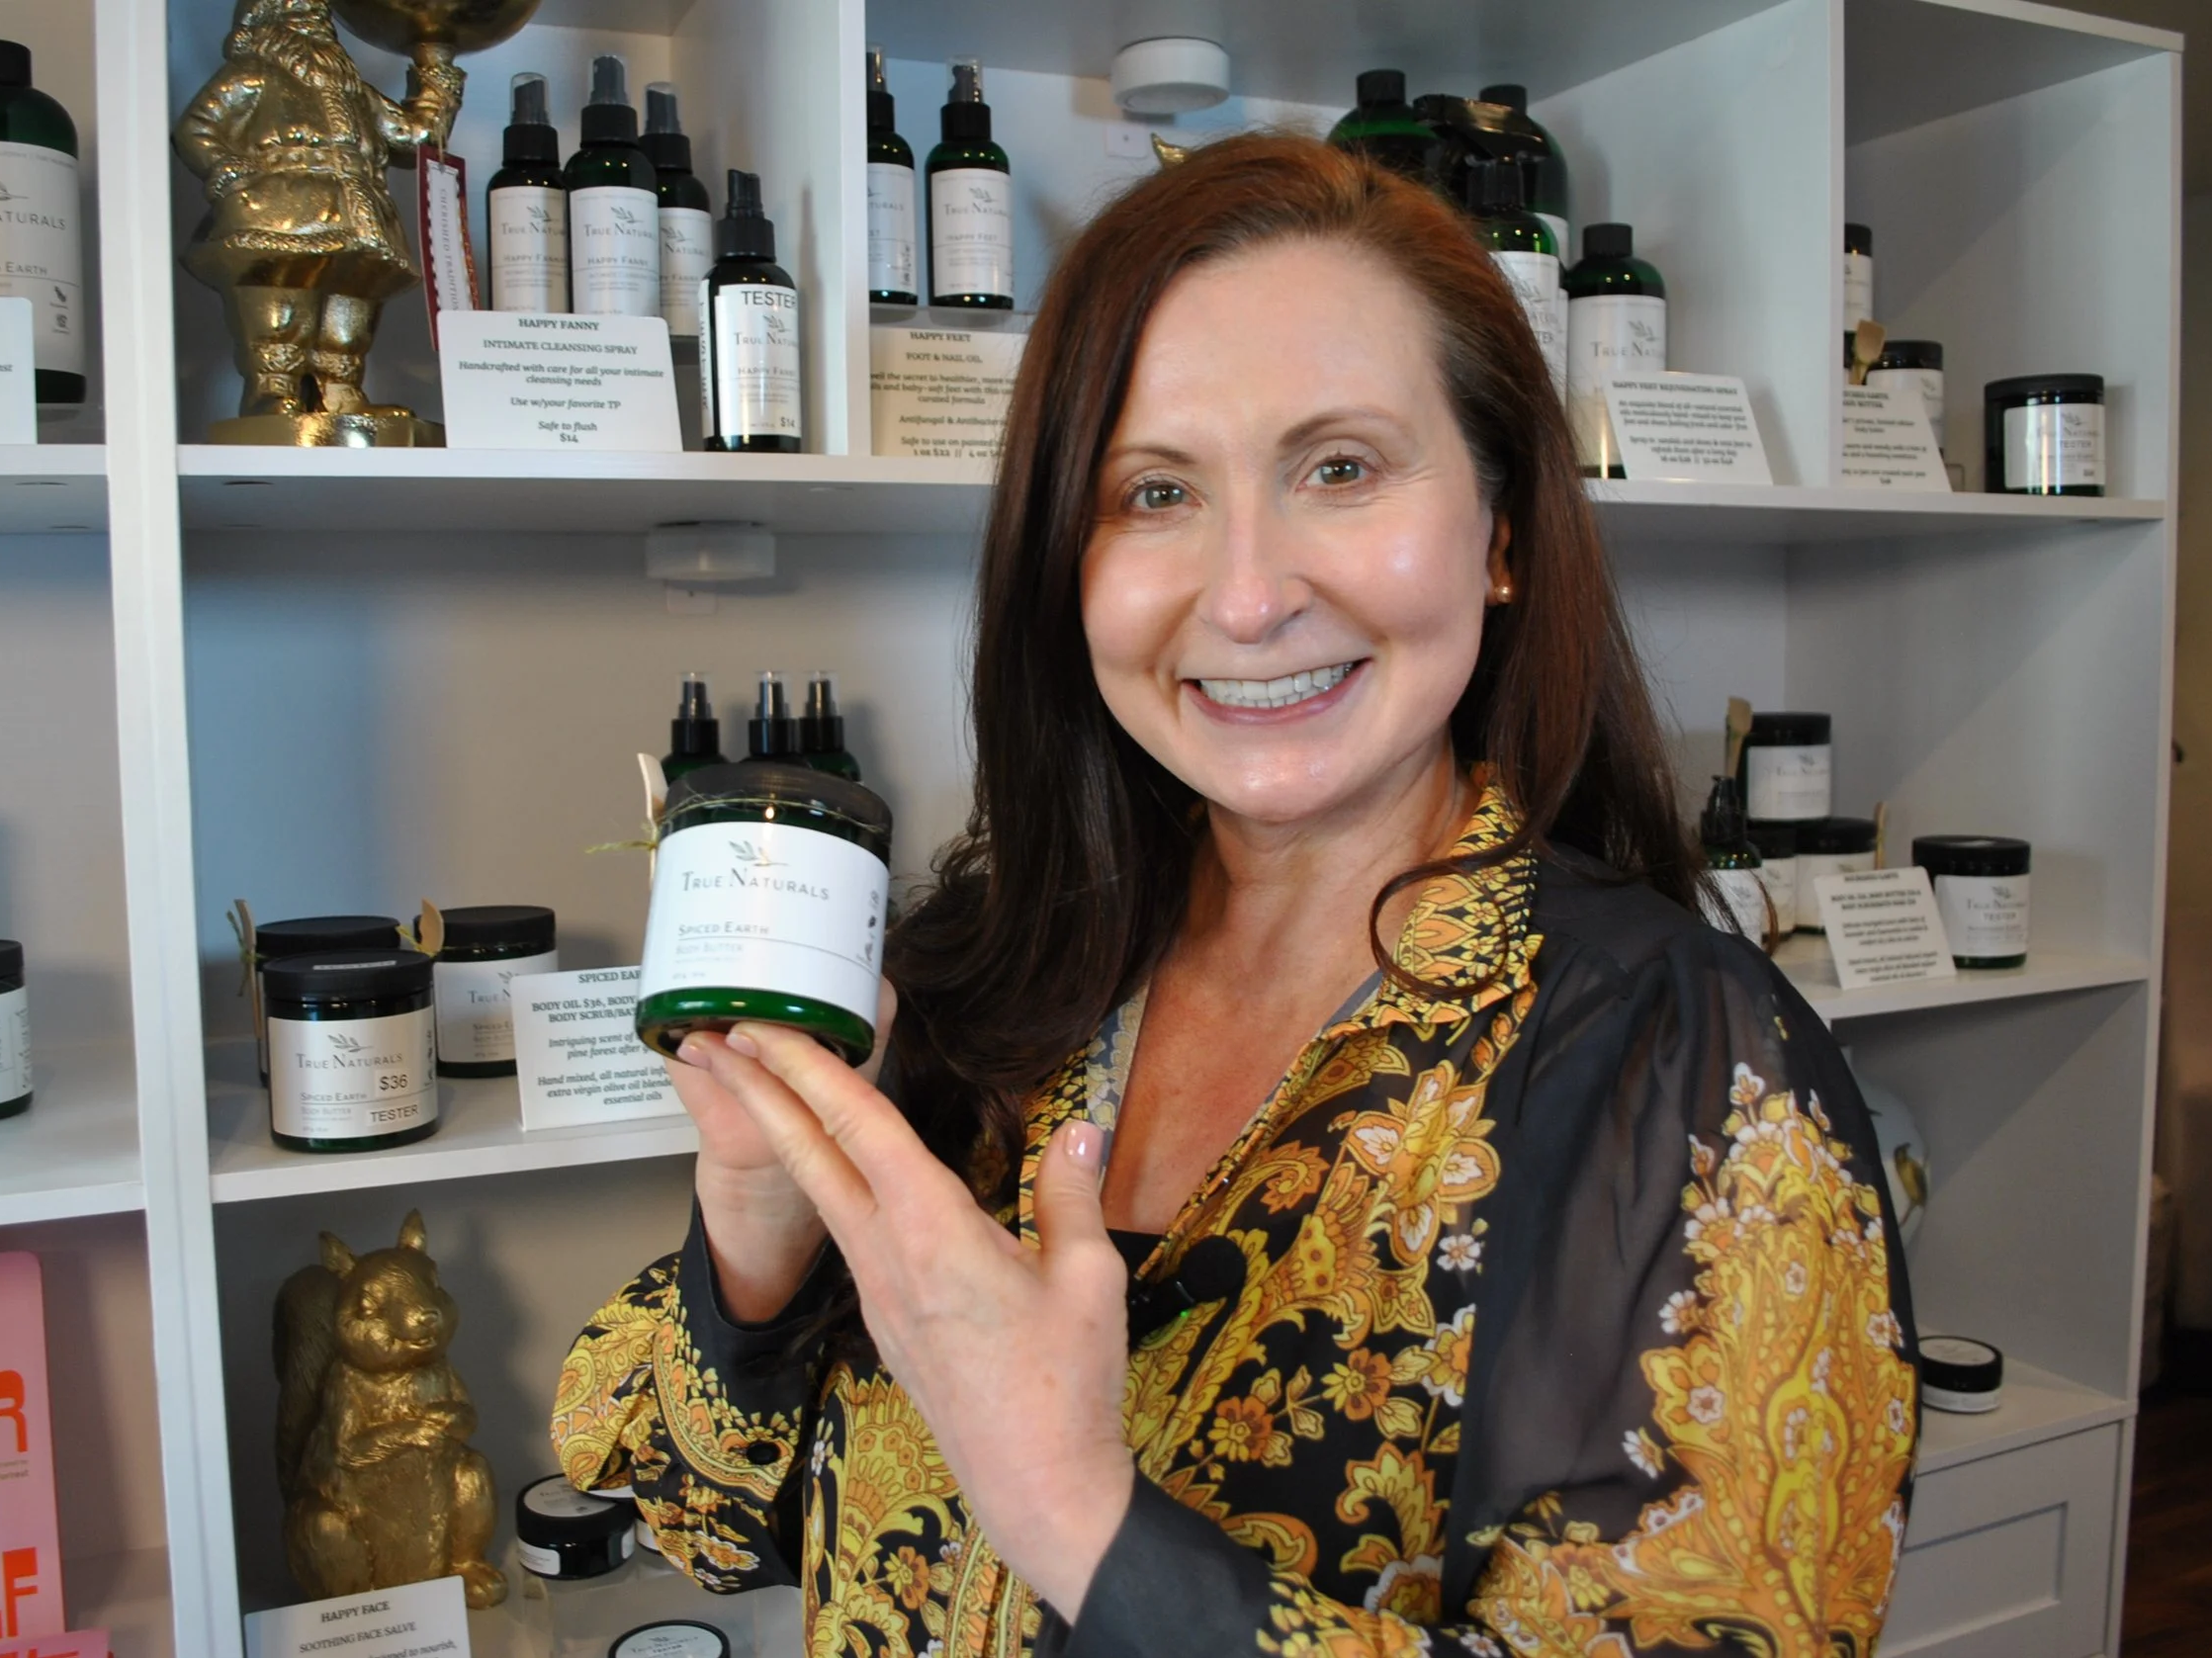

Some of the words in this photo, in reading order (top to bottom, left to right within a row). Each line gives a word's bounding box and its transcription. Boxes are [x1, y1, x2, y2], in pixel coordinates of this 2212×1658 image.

[0, 210, 66, 231] TURALS
[584, 224, 611, 237] TRUE
[6, 261, 48, 276] EARTH
[519, 318, 557, 329] HAPPY
[561, 320, 599, 330] FANNY
[910, 331, 944, 341] HAPPY
[946, 333, 971, 342] FEET
[484, 339, 539, 350] INTIMATE
[541, 341, 602, 353] CLEANSING
[604, 344, 638, 355] SPRAY
[906, 352, 930, 361] FOOT
[459, 361, 520, 373] Handcrafted
[523, 363, 545, 373] with
[570, 365, 583, 377] for
[585, 366, 598, 376] all
[599, 368, 621, 379] your
[623, 367, 664, 378] intimate
[525, 375, 573, 387] cleansing
[575, 377, 602, 387] needs
[510, 397, 529, 406] Use
[531, 397, 565, 409] w/your
[567, 398, 605, 410] favorite
[607, 400, 621, 409] TP
[538, 421, 559, 432] Safe
[574, 421, 597, 432] flush
[560, 432, 578, 443] $14
[901, 436, 919, 446] Safe
[682, 871, 723, 891] TRUE
[730, 867, 830, 901] NATURALS
[678, 923, 720, 936] SPICED
[724, 921, 769, 934] EARTH
[578, 971, 619, 984] SPICED
[621, 970, 641, 980] EAR
[532, 1001, 561, 1011] BODY
[563, 1000, 581, 1010] OIL
[607, 996, 636, 1006] BODY
[549, 1010, 577, 1022] BODY
[549, 1035, 596, 1048] Intriguing
[598, 1035, 624, 1044] scent
[625, 1032, 635, 1044] of
[568, 1049, 588, 1061] pine
[589, 1047, 616, 1059] forest
[618, 1044, 641, 1057] after
[296, 1053, 329, 1069] TRUE
[332, 1053, 403, 1070] NATURALS
[379, 1074, 407, 1091] $36
[537, 1076, 565, 1086] Hand
[567, 1072, 597, 1084] mixed,
[599, 1071, 612, 1080] all
[614, 1068, 649, 1080] natural
[301, 1092, 332, 1101] SPICED
[547, 1089, 572, 1098] extra
[574, 1085, 602, 1096] virgin
[603, 1082, 627, 1092] olive
[628, 1080, 641, 1090] oil
[603, 1093, 645, 1105] essential
[646, 1091, 663, 1101] oils
[370, 1104, 418, 1122] TESTER
[320, 1606, 360, 1622] HAPPY
[362, 1601, 391, 1615] FACE
[300, 1633, 355, 1653] SOOTHING
[357, 1628, 384, 1642] FACE
[385, 1621, 416, 1636] SALVE
